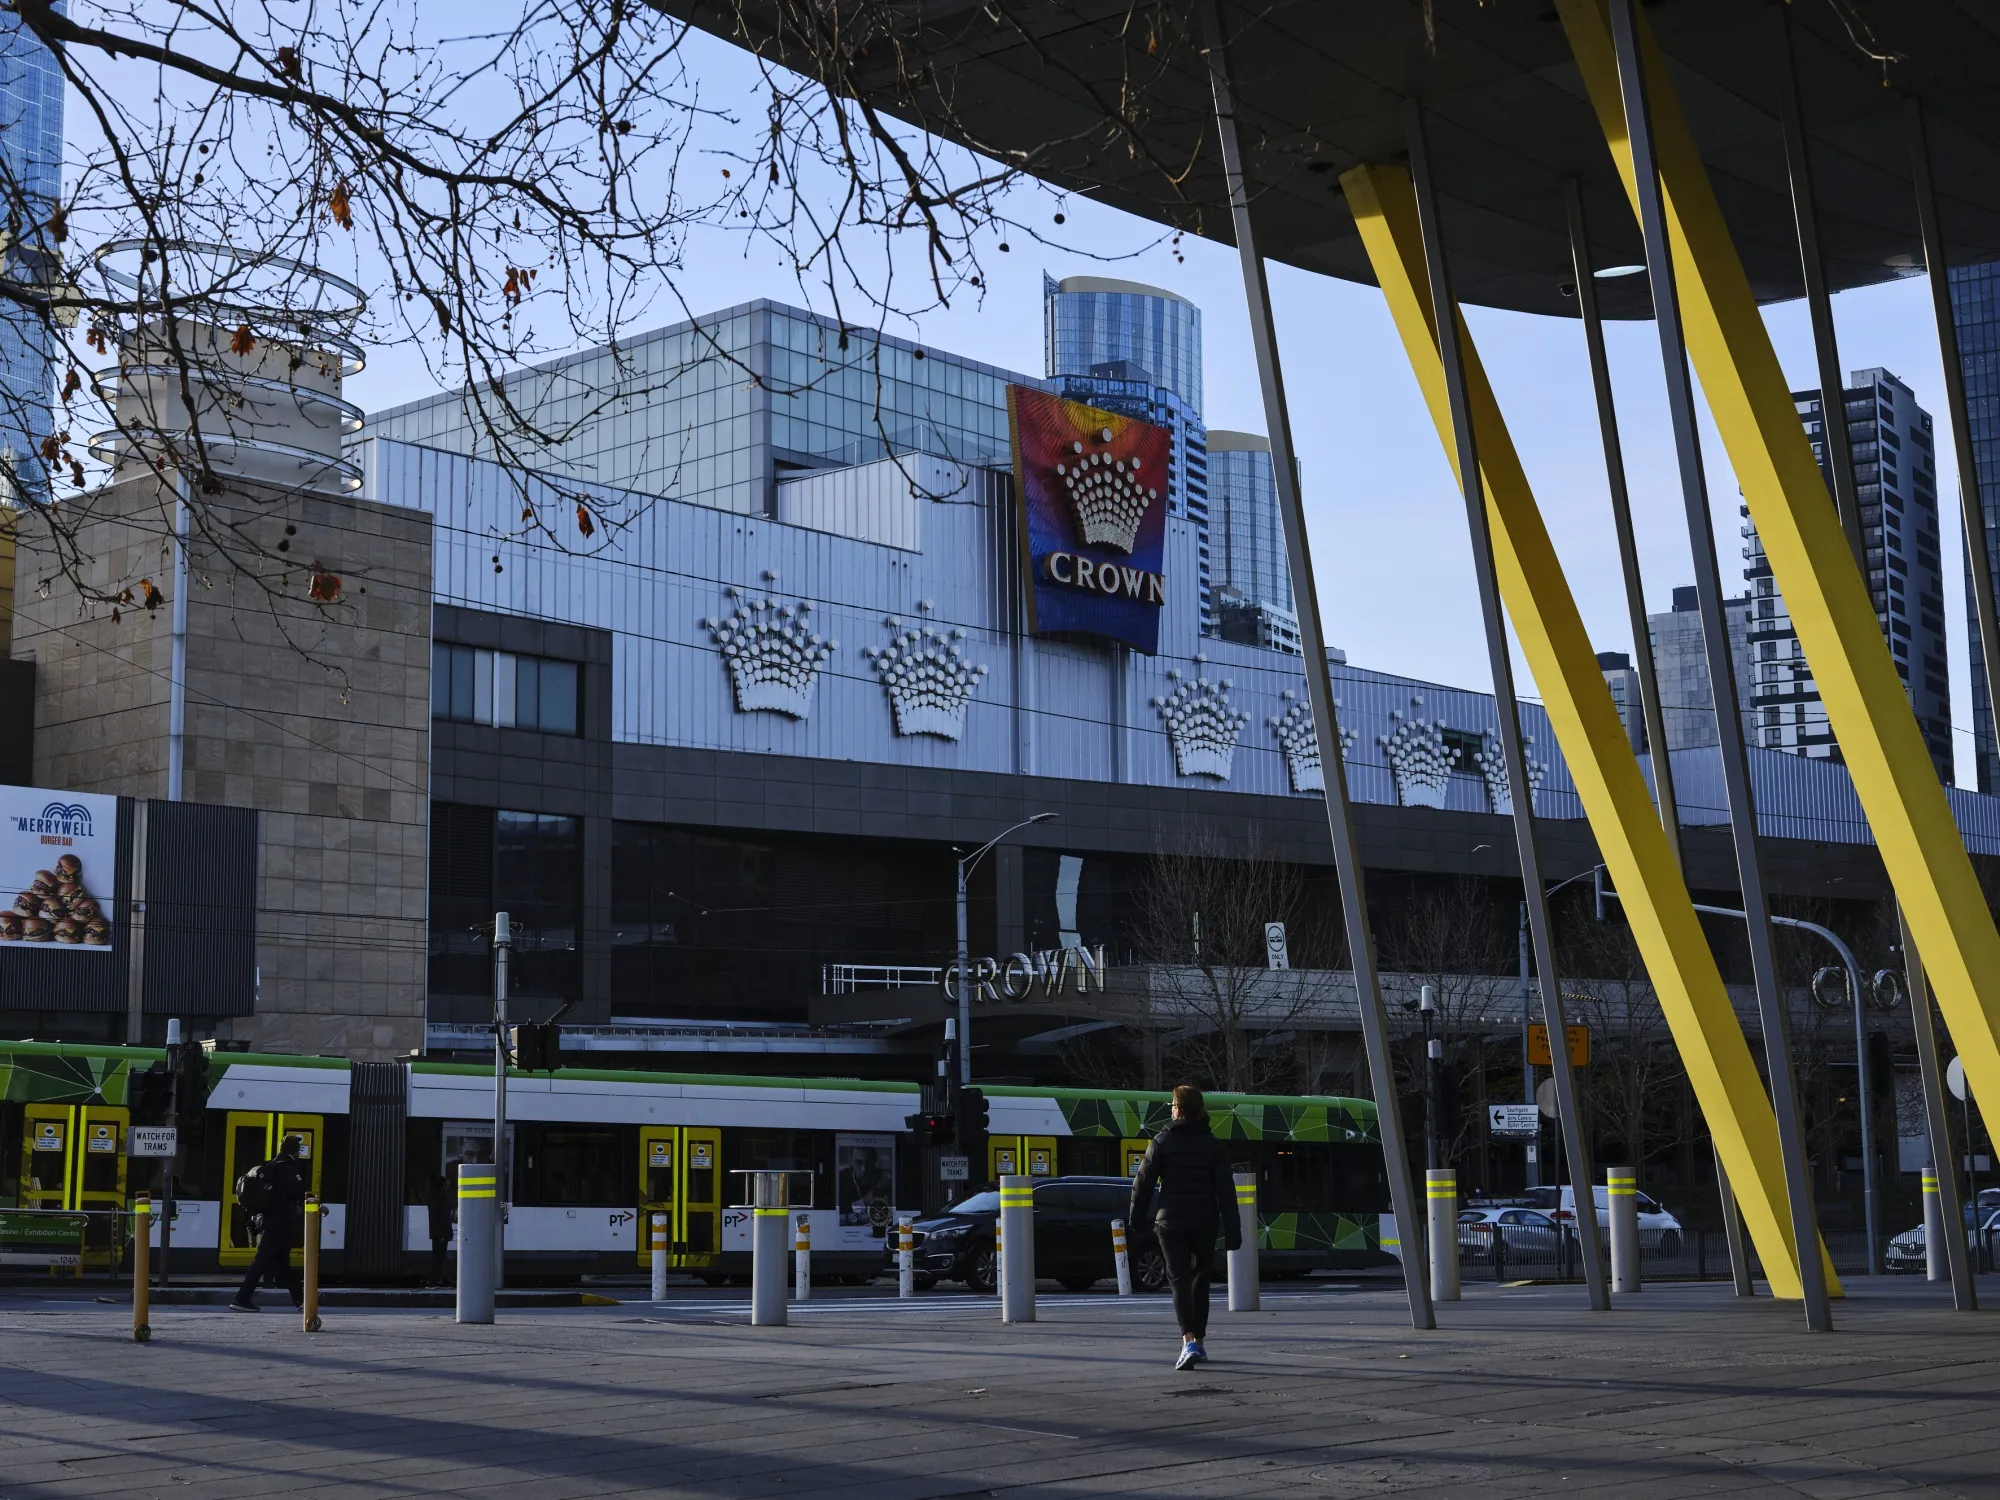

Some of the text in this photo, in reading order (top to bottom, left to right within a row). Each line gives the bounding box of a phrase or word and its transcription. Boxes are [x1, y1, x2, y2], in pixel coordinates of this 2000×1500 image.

[1049, 551, 1166, 606] CROWN
[18, 817, 94, 837] MERRYWELL
[40, 835, 73, 846] BURGER BAR
[940, 943, 1106, 1002] CROWN
[136, 1132, 176, 1141] WATCH FOR
[144, 1142, 168, 1151] TRAMS
[57, 1229, 80, 1237] Centre
[60, 1256, 78, 1264] 124A
